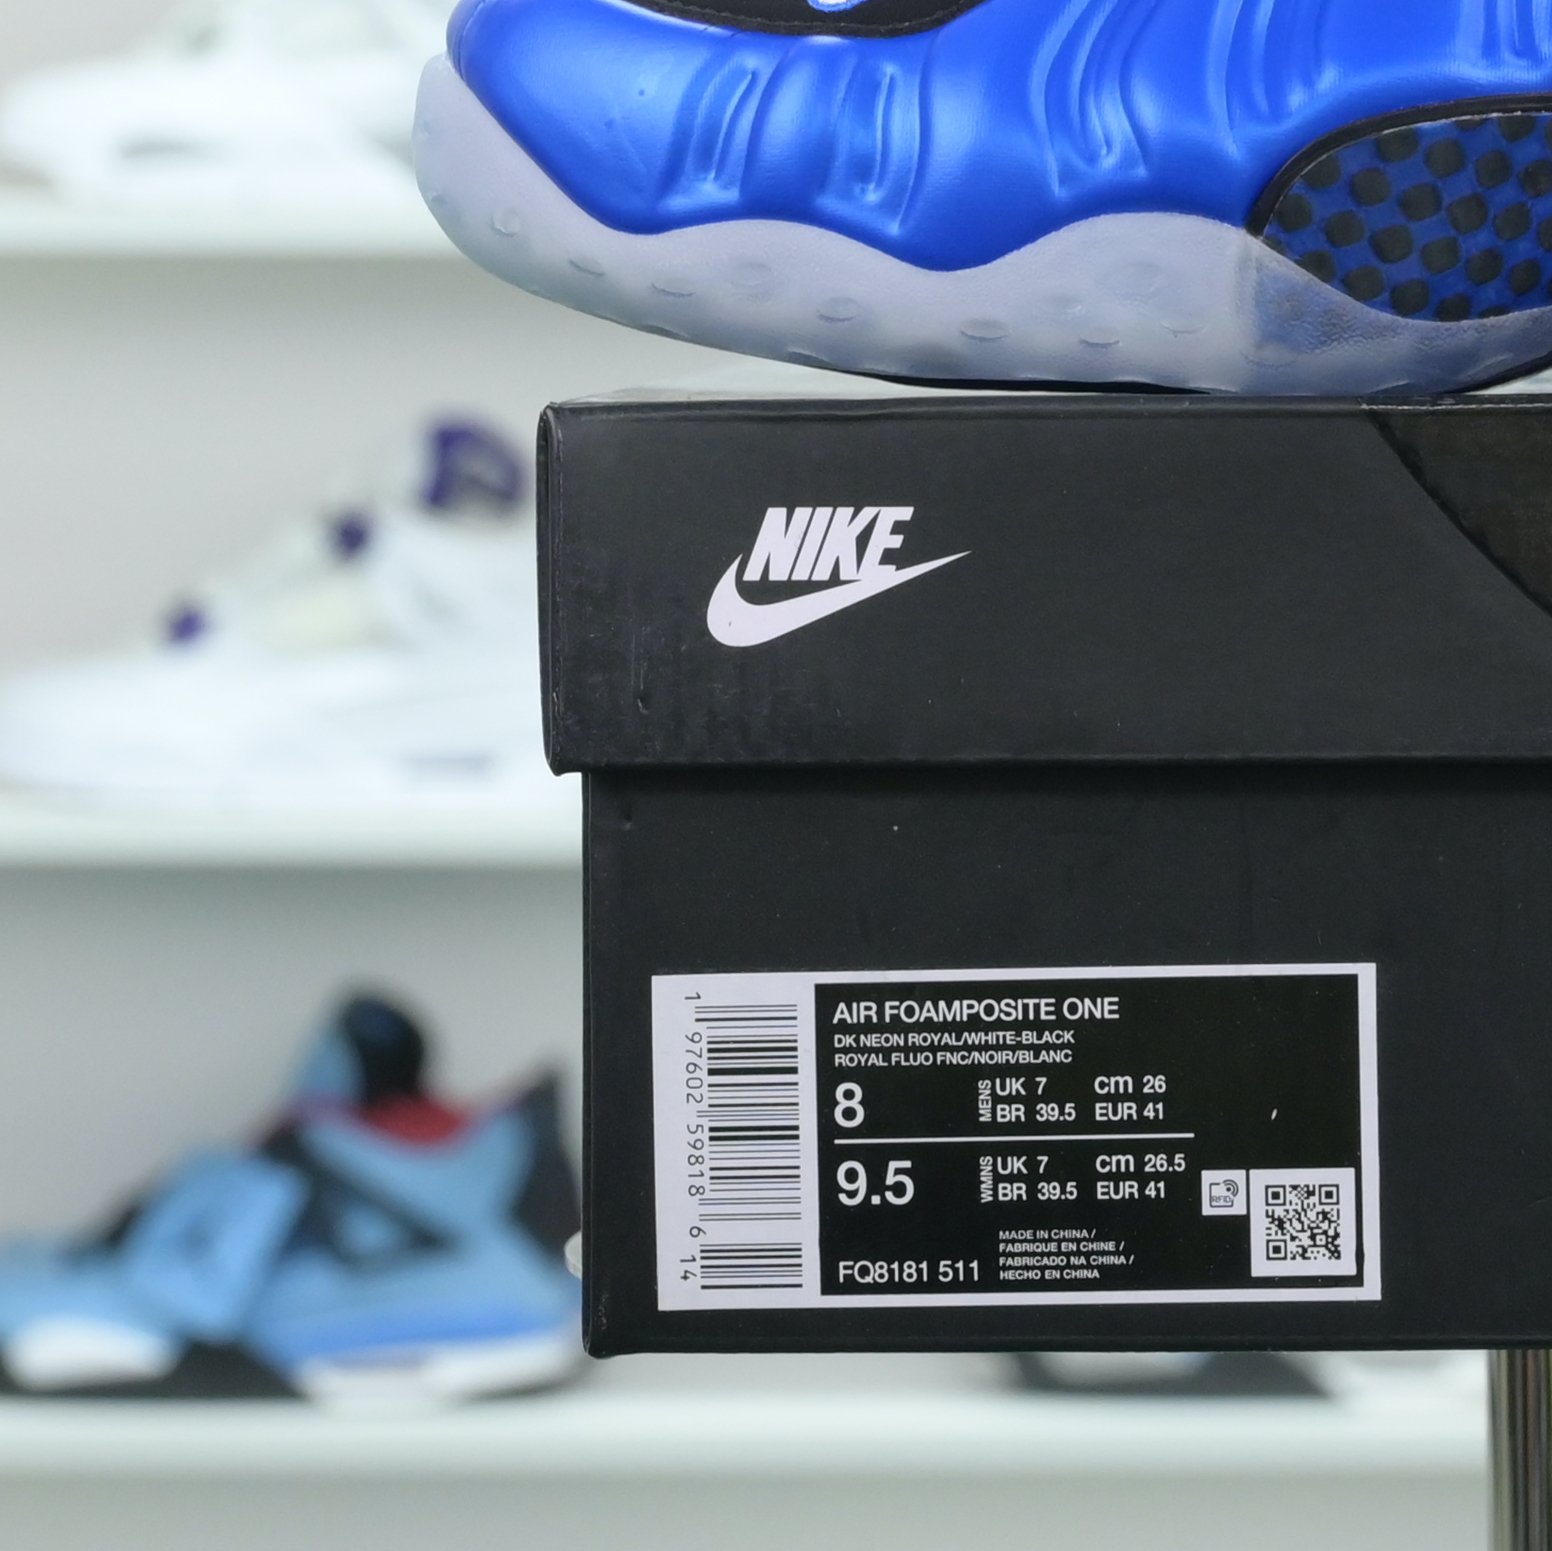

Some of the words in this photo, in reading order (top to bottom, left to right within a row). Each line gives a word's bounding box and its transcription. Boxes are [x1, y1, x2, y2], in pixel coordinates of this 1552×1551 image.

[742, 506, 914, 581] NIKE
[833, 1002, 877, 1024] AIR
[885, 998, 1056, 1023] FOAMPOSITE
[1063, 997, 1119, 1020] ONE
[834, 1034, 856, 1047] DK
[860, 1033, 904, 1047] NEON
[908, 1030, 1075, 1046] ROYAL/WHITE-BLACK
[686, 1032, 703, 1103] 97602
[835, 1053, 888, 1067] ROYAL
[892, 1052, 933, 1065] FLUO
[937, 1049, 1072, 1065] FNC/NOIR/BLANC
[996, 1077, 1026, 1096] UK
[1035, 1077, 1047, 1095] 7
[1094, 1076, 1132, 1094] cm
[1143, 1075, 1166, 1093] 26
[834, 1082, 864, 1128] 8
[978, 1080, 991, 1121] MENS
[997, 1104, 1025, 1122] BR
[1036, 1103, 1076, 1121] 39.5
[1095, 1102, 1137, 1120] EUR
[1143, 1102, 1163, 1119] 41
[687, 1125, 705, 1196] 59818
[997, 1156, 1027, 1174] UK
[1037, 1156, 1048, 1173] 7
[1096, 1155, 1134, 1173] cm
[1145, 1154, 1185, 1172] 26.5
[837, 1160, 914, 1206] 9.5
[980, 1156, 993, 1203] WMNS
[998, 1183, 1026, 1201] BR
[1038, 1182, 1077, 1200] 39.5
[1097, 1181, 1138, 1199] EUR
[1145, 1181, 1164, 1198] 41
[690, 1226, 706, 1237] 6
[999, 1230, 1033, 1239] MADE
[1037, 1230, 1048, 1239] IN
[1051, 1229, 1089, 1239] CHINA
[999, 1242, 1058, 1252] FABRIQUE
[1061, 1242, 1076, 1251] EN
[1080, 1242, 1115, 1251] CHINE
[680, 1255, 697, 1280] 14
[1000, 1256, 1067, 1266] FABRICADO
[1070, 1256, 1086, 1265] NA
[1090, 1255, 1126, 1265] CHINA
[839, 1261, 927, 1283] FQ8181
[939, 1260, 978, 1282] 511
[1000, 1270, 1041, 1280] HECHO
[1045, 1270, 1060, 1279] EN
[1063, 1269, 1099, 1279] CHINA
